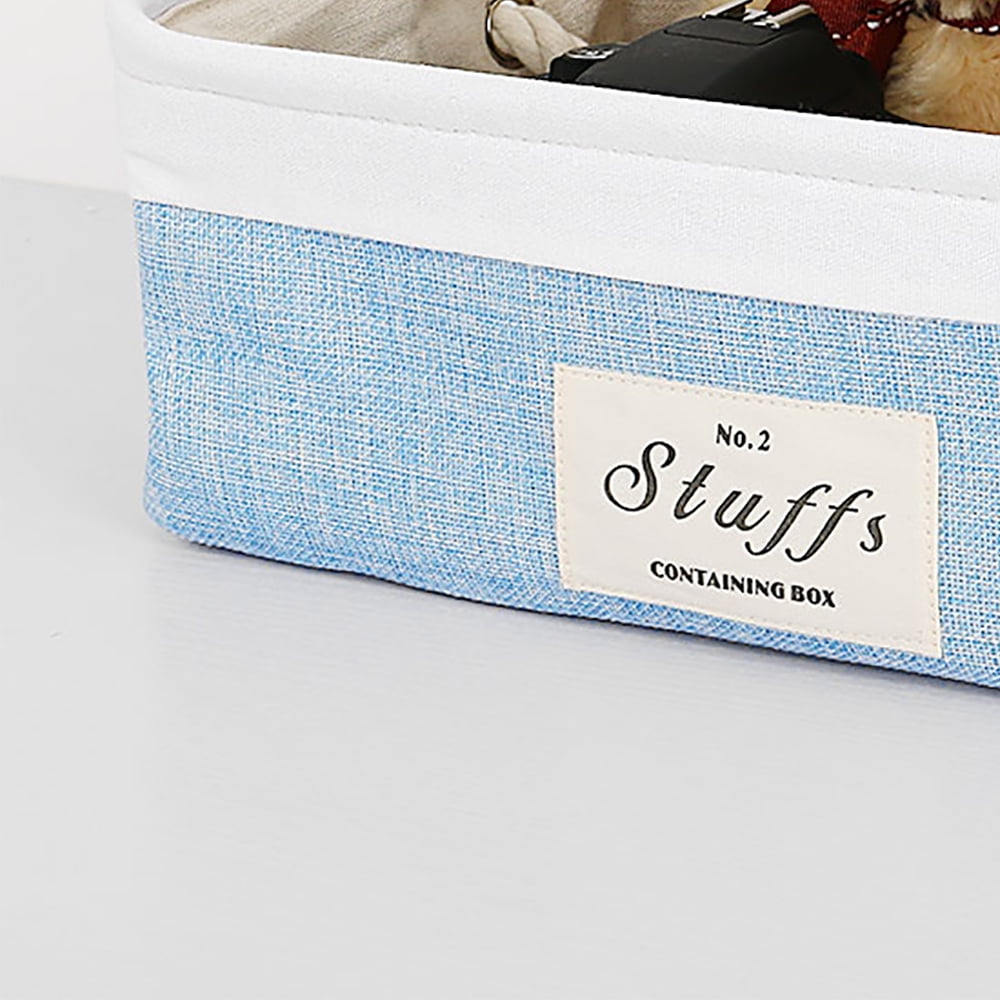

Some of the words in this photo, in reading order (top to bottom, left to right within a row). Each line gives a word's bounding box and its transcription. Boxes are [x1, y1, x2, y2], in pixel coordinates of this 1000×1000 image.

[603, 441, 887, 563] Stuffs
[650, 560, 785, 600] CONTAINING
[790, 584, 836, 609] BOX
